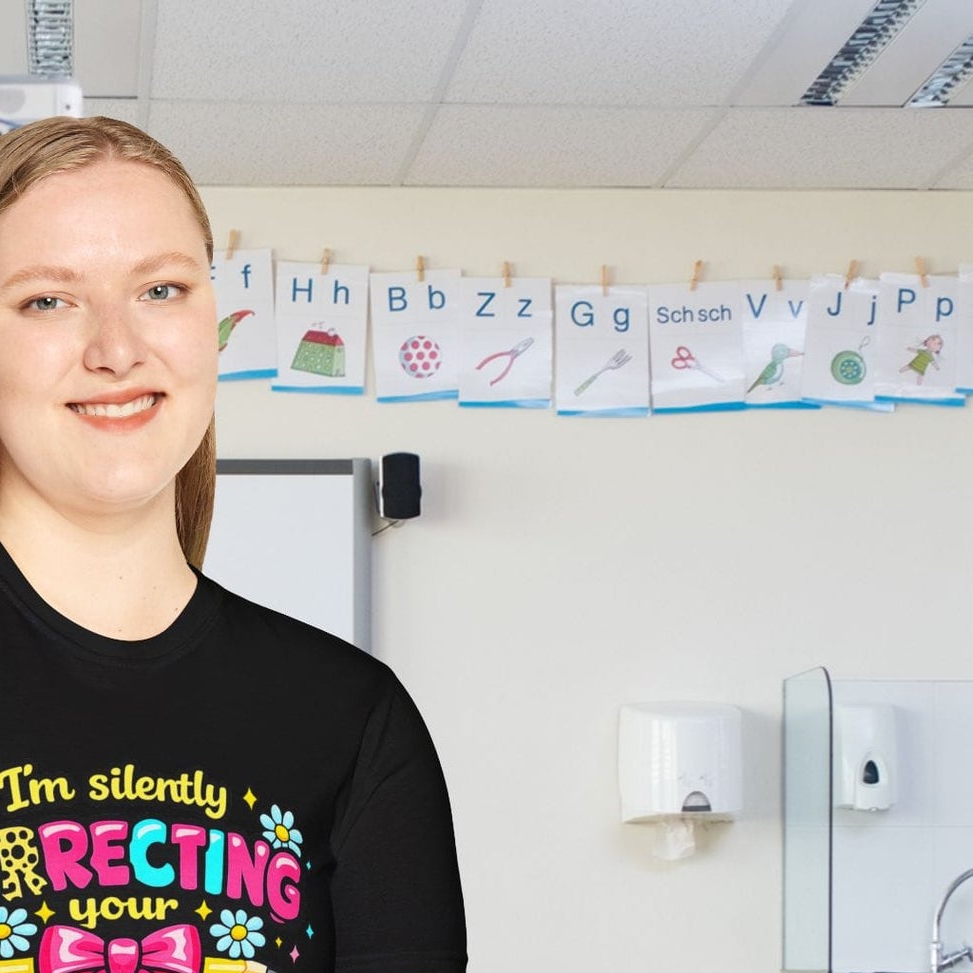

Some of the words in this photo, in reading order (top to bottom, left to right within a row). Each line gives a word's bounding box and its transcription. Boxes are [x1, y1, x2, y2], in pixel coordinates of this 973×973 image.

[241, 263, 252, 289] f
[291, 277, 313, 303] H
[333, 279, 350, 305] h
[387, 286, 408, 312] B
[427, 284, 446, 310] b
[475, 292, 496, 318] Z
[517, 298, 533, 318] z
[897, 288, 917, 313] P
[935, 297, 954, 322] p
[570, 300, 595, 327] G
[612, 307, 630, 333] g
[656, 305, 694, 324] Sch
[697, 304, 732, 323] sch
[746, 293, 768, 319] V
[787, 299, 804, 318] v
[826, 291, 843, 317] J
[866, 295, 877, 326] j
[89, 764, 227, 819] silently
[69, 897, 178, 928] your
